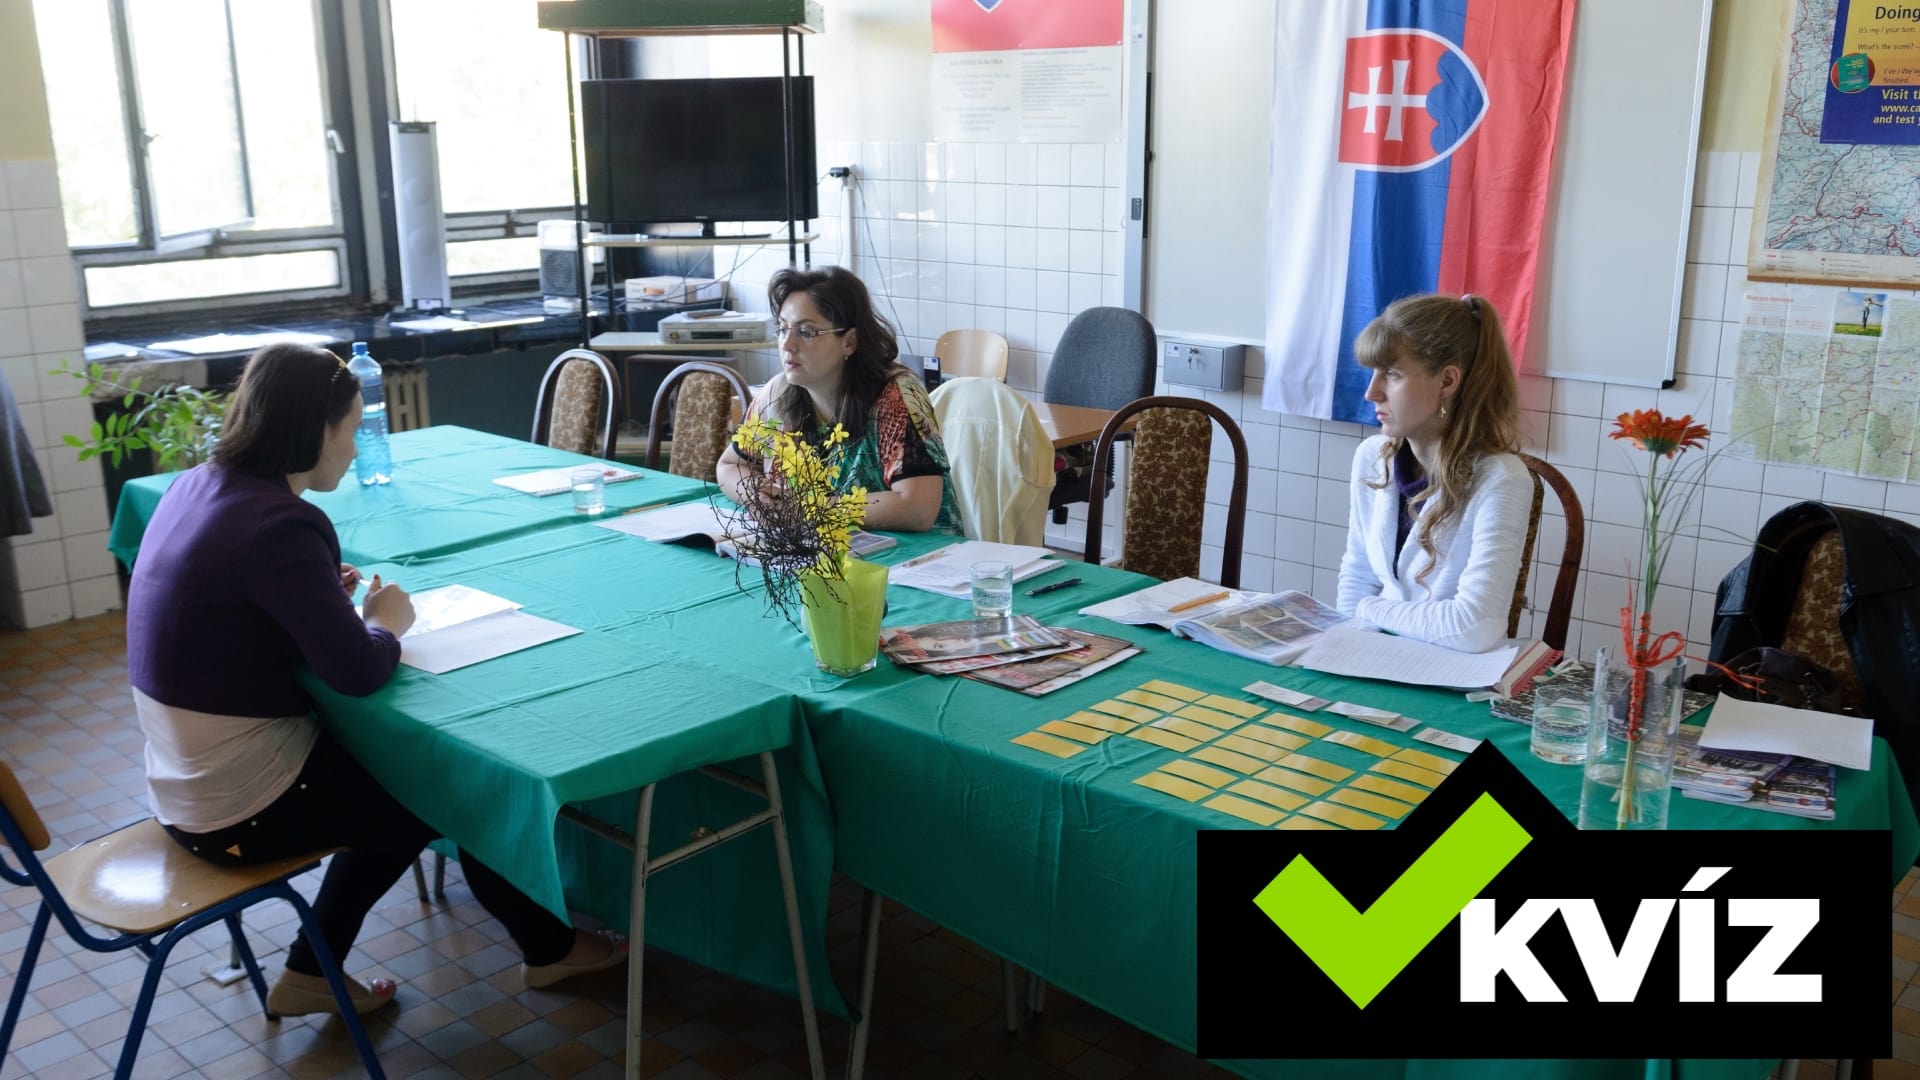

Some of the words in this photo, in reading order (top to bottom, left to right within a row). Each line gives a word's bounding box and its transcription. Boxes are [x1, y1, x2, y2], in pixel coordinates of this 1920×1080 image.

[1875, 5, 1920, 22] Doing
[1881, 88, 1909, 100] Visit
[1873, 114, 1893, 124] and
[1895, 115, 1916, 124] test
